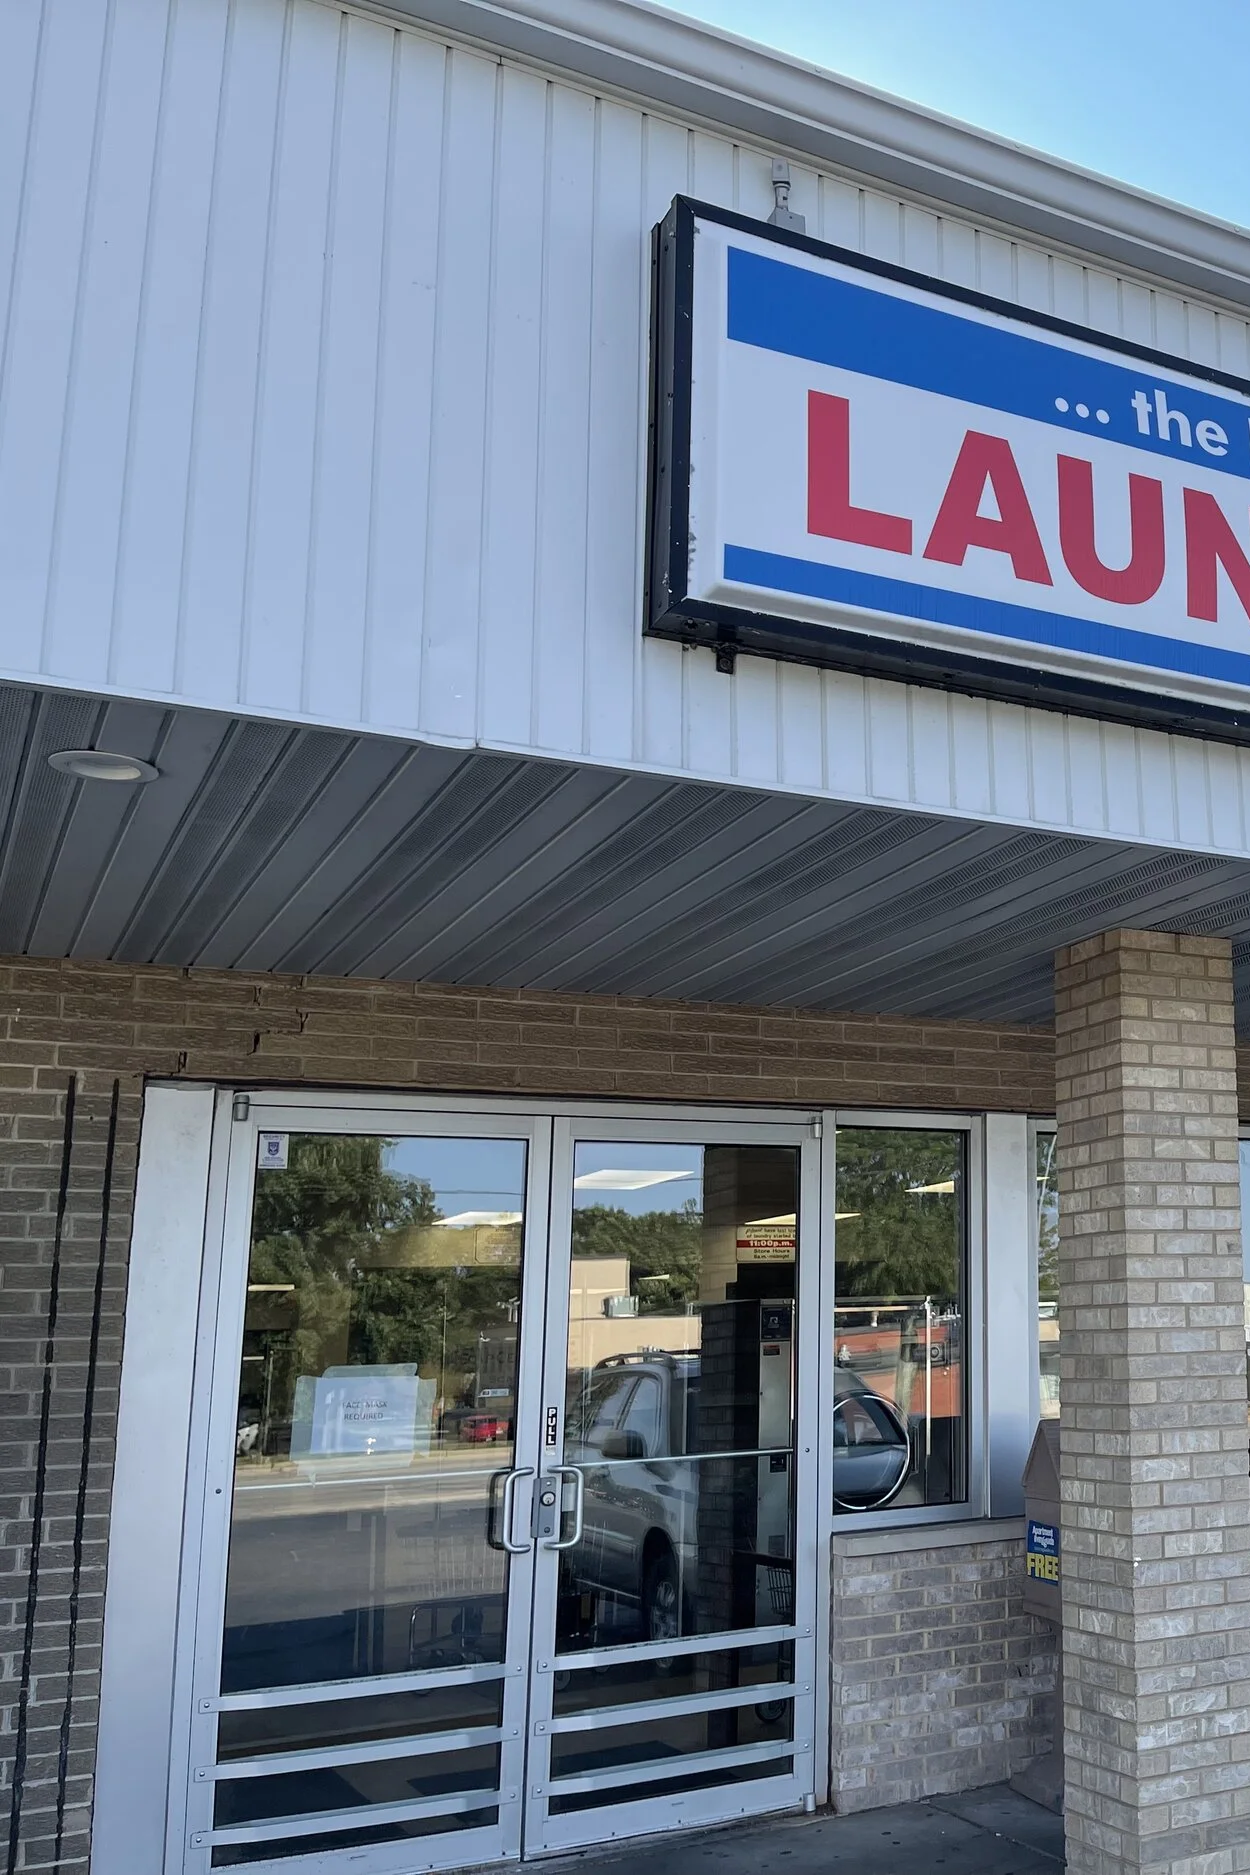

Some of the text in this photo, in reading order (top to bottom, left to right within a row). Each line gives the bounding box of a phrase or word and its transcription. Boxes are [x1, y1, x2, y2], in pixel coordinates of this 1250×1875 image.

[1131, 388, 1229, 457] the
[343, 1412, 384, 1420] REQUIRED
[364, 1400, 388, 1409] MASK
[547, 1408, 556, 1444] PULL
[1027, 1552, 1059, 1581] FREE
